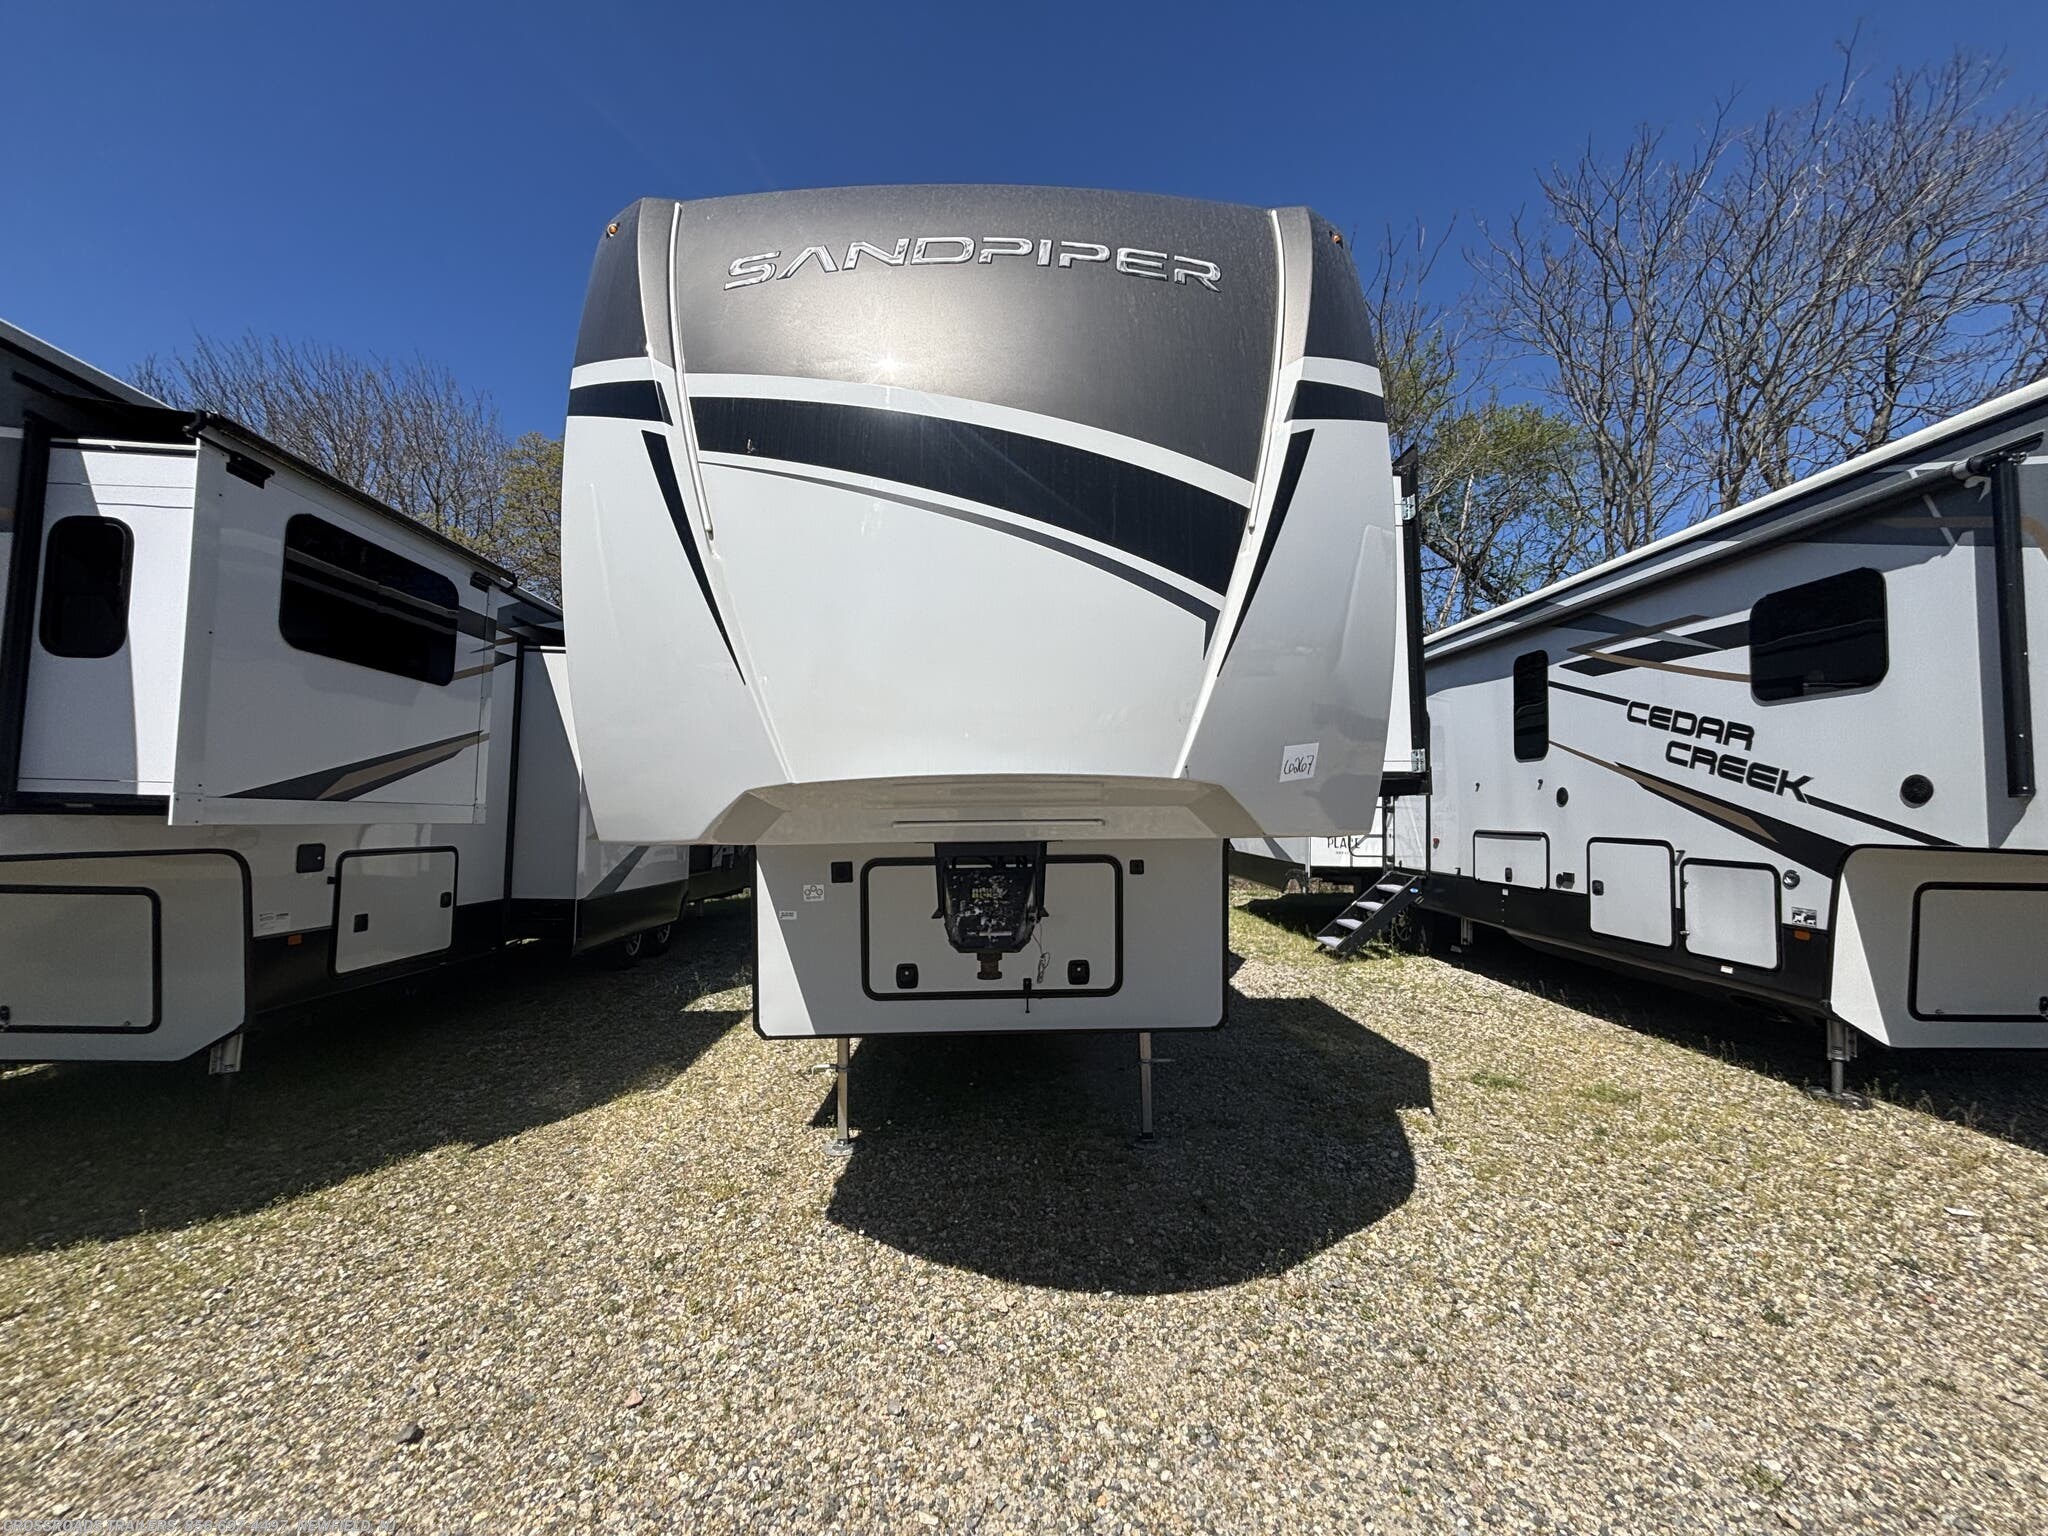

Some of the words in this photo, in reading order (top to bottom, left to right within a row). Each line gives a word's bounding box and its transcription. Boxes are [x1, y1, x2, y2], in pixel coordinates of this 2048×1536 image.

[723, 237, 1222, 292] SANDPIPER
[1627, 701, 1755, 751] CEDAR
[1665, 740, 1814, 804] CREEK
[1327, 836, 1361, 848] PLAE
